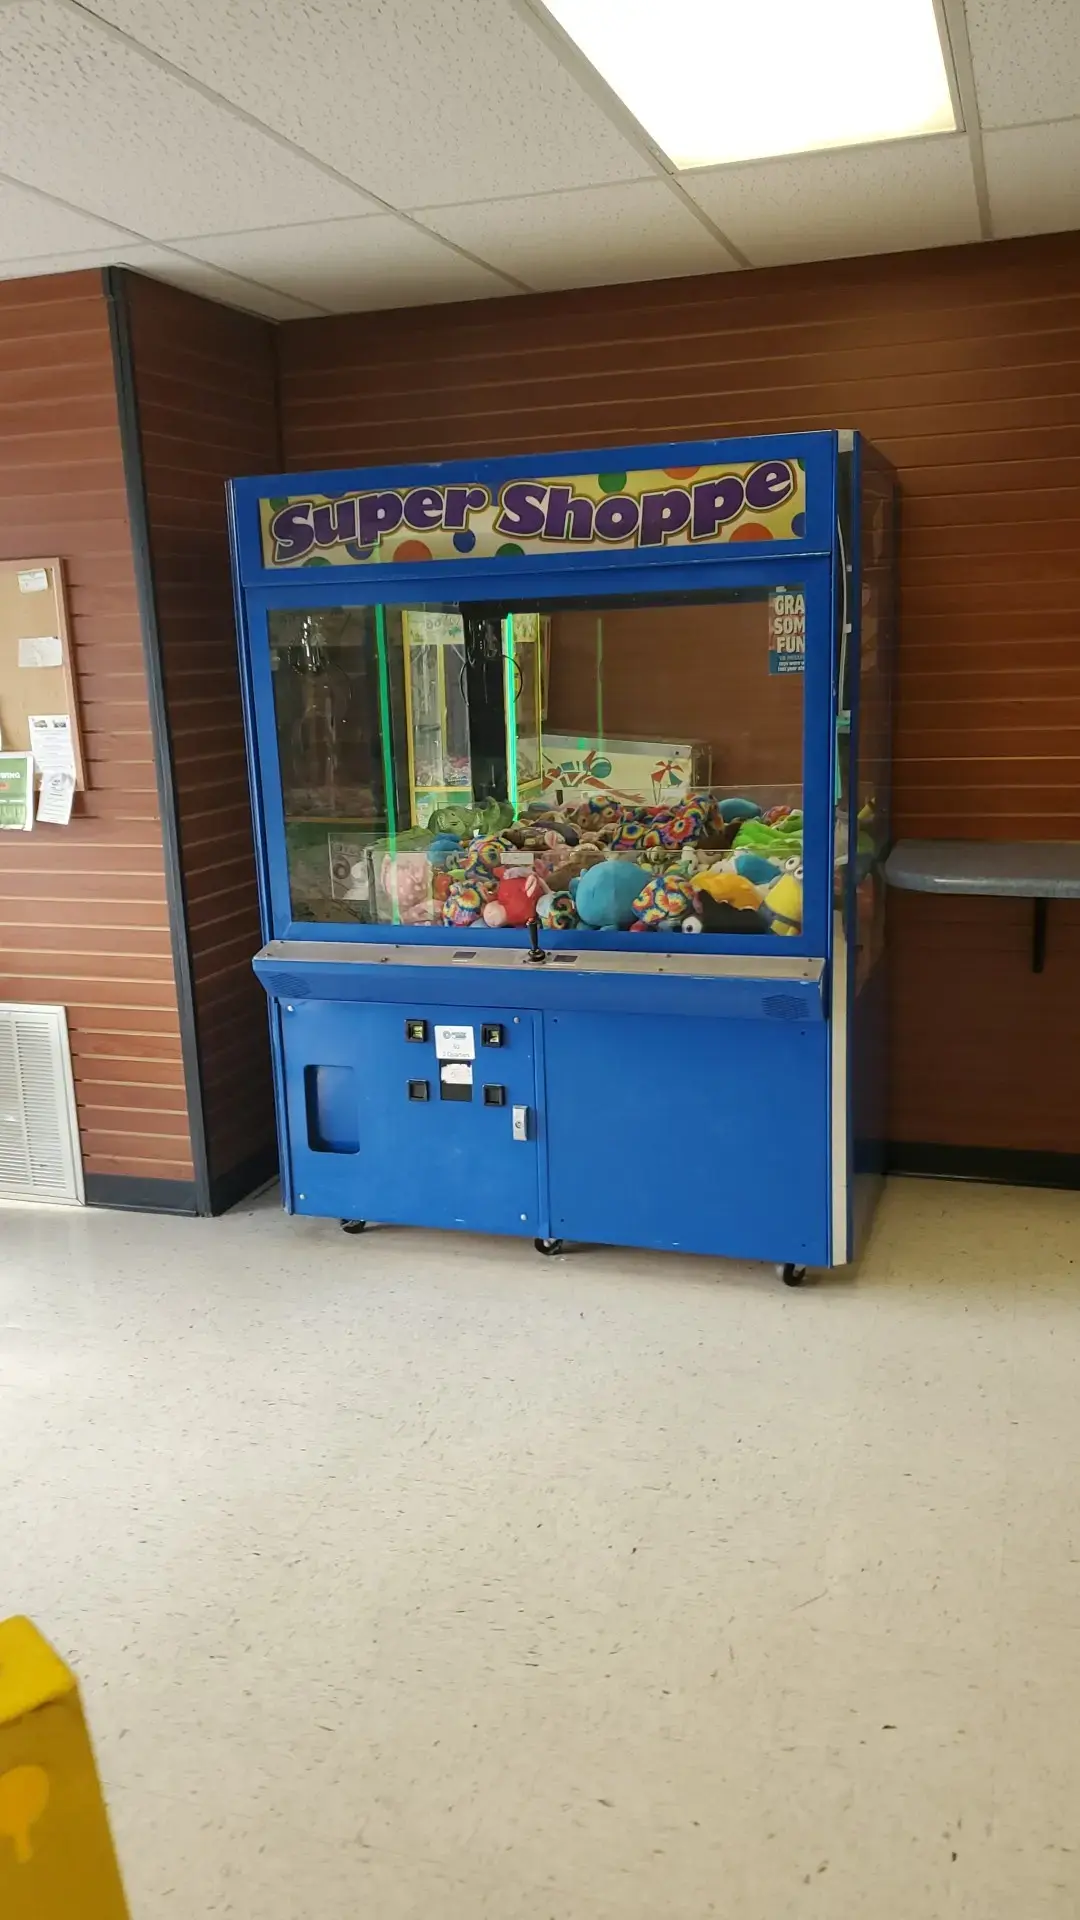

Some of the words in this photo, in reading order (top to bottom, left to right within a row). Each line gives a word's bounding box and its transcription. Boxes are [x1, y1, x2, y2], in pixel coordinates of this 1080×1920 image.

[272, 486, 490, 562] Super
[495, 460, 794, 548] Shoppe
[776, 635, 805, 654] FUN
